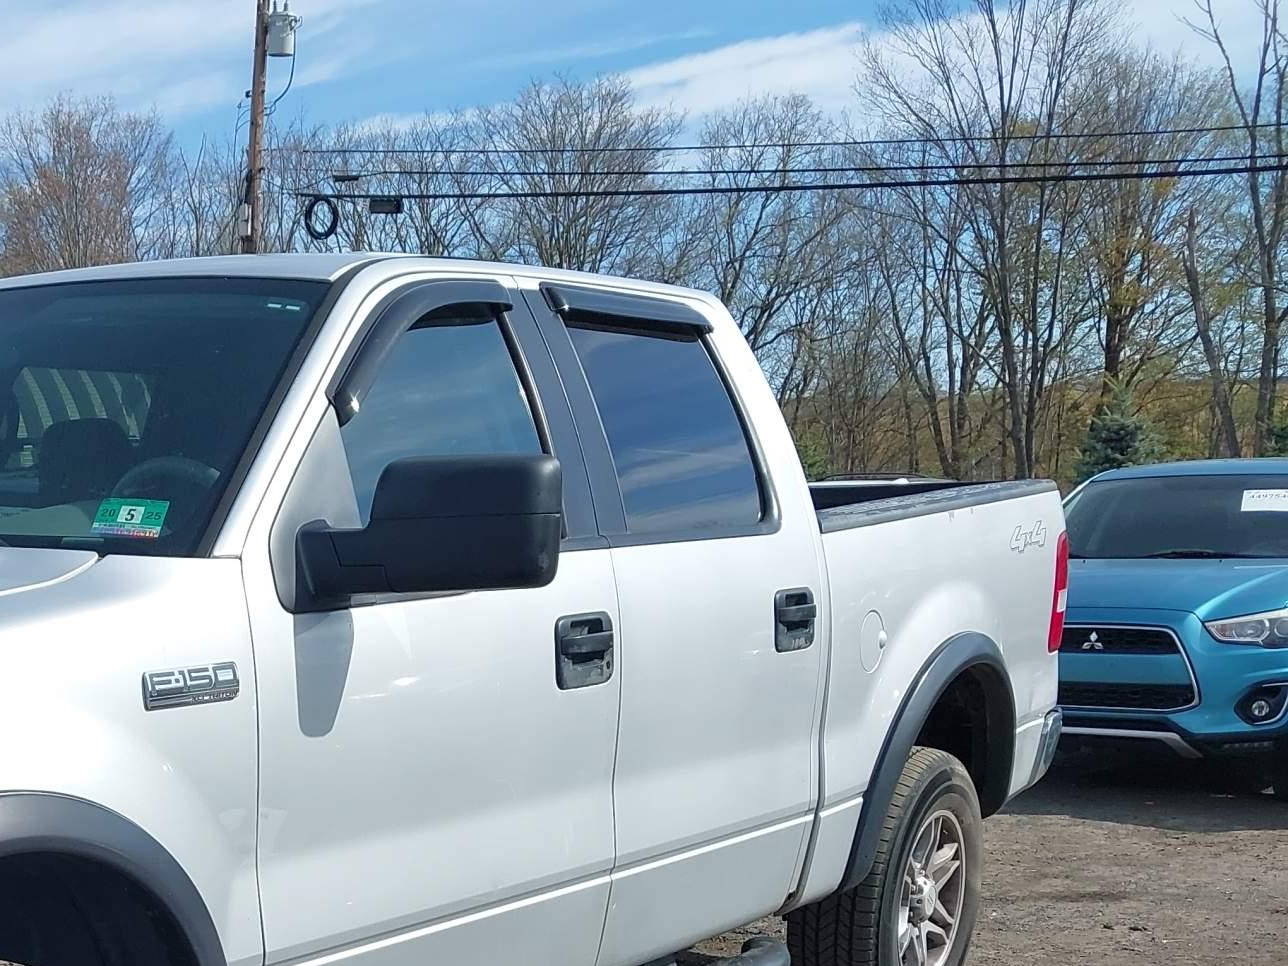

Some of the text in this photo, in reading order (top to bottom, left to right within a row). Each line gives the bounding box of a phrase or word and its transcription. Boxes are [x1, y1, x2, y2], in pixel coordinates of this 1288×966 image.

[100, 508, 162, 521] 20 5 25
[1009, 519, 1047, 553] 4x4
[146, 663, 237, 696] F-150
